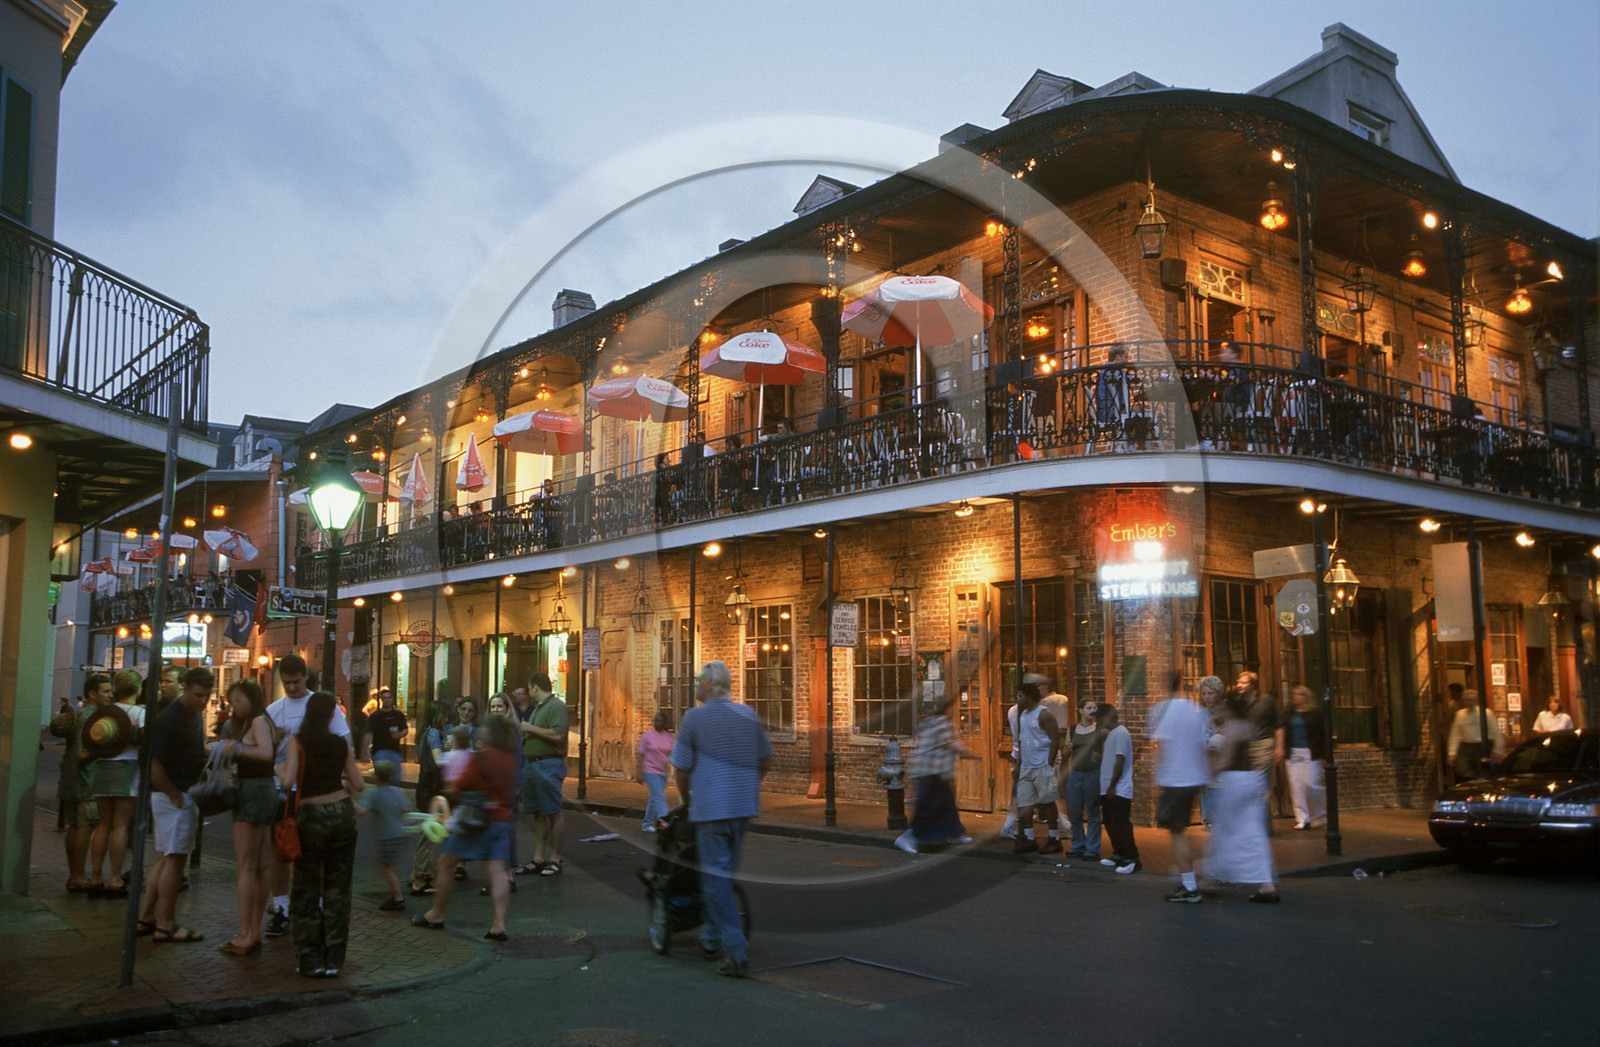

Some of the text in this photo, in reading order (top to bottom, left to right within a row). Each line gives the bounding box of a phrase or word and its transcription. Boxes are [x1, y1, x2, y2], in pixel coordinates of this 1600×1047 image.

[738, 341, 770, 349] Coke
[1110, 522, 1176, 541] Ember's
[1101, 581, 1197, 599] STEAK HOUSE
[293, 598, 323, 613] Peter
[833, 602, 857, 611] DELIVERY
[835, 616, 856, 624] SERVICE
[833, 623, 857, 632] VEHICLES
